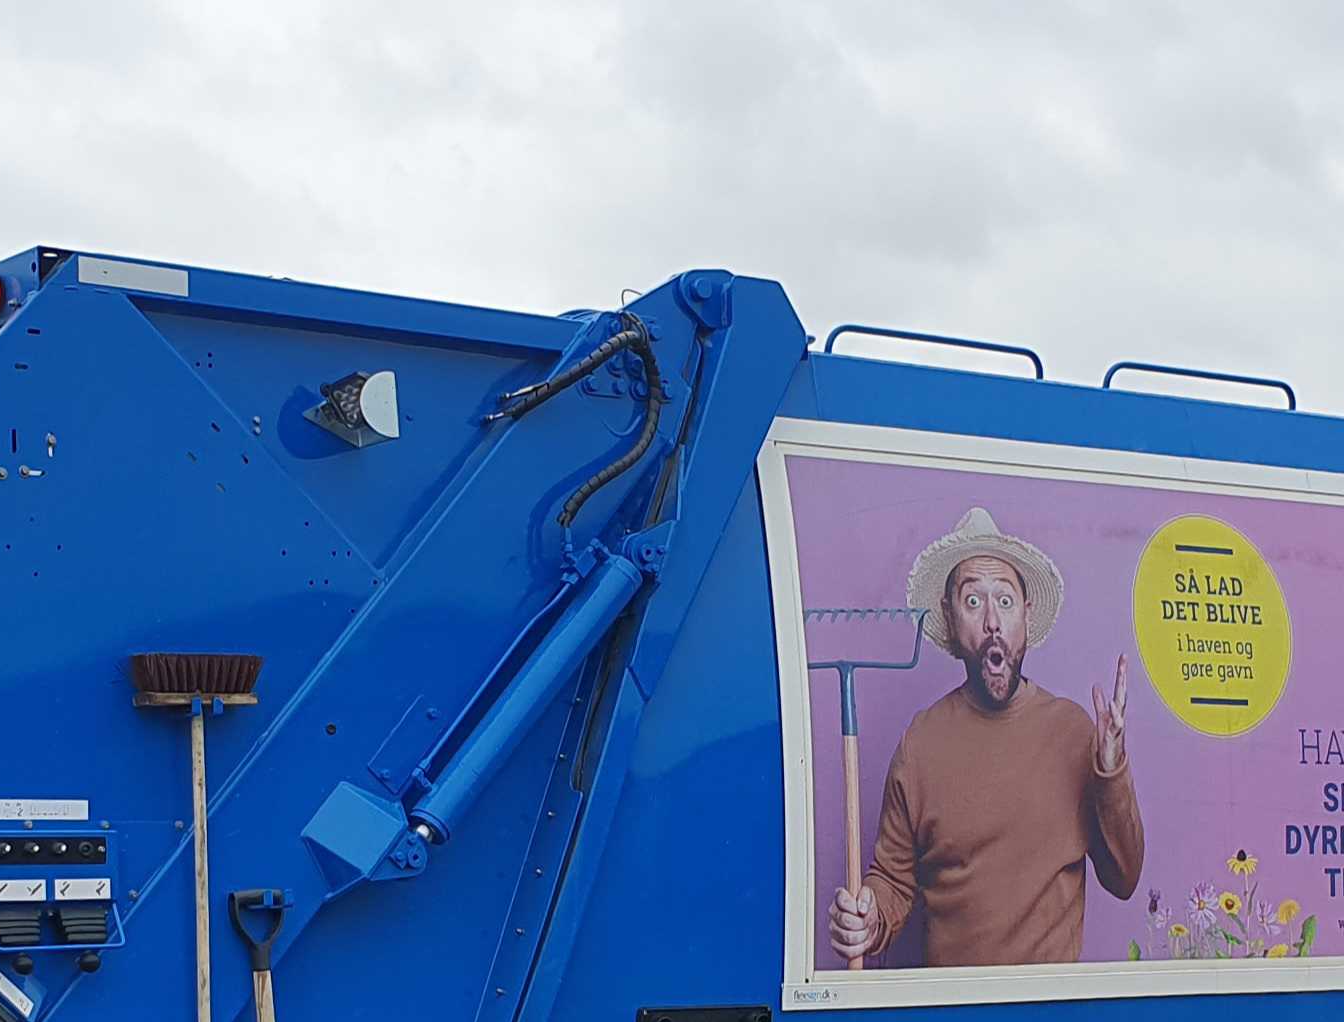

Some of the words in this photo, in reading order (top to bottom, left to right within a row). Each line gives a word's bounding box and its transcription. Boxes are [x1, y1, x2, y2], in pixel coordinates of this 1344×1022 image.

[1175, 568, 1200, 594] SÅ
[1205, 575, 1243, 596] LAD
[1161, 600, 1200, 622] DET
[1205, 603, 1263, 625] BLIVE
[1177, 633, 1183, 652] i
[1185, 633, 1232, 655] haven
[1235, 641, 1253, 660] og
[1181, 662, 1213, 681] gøre
[1217, 664, 1254, 682] gavn
